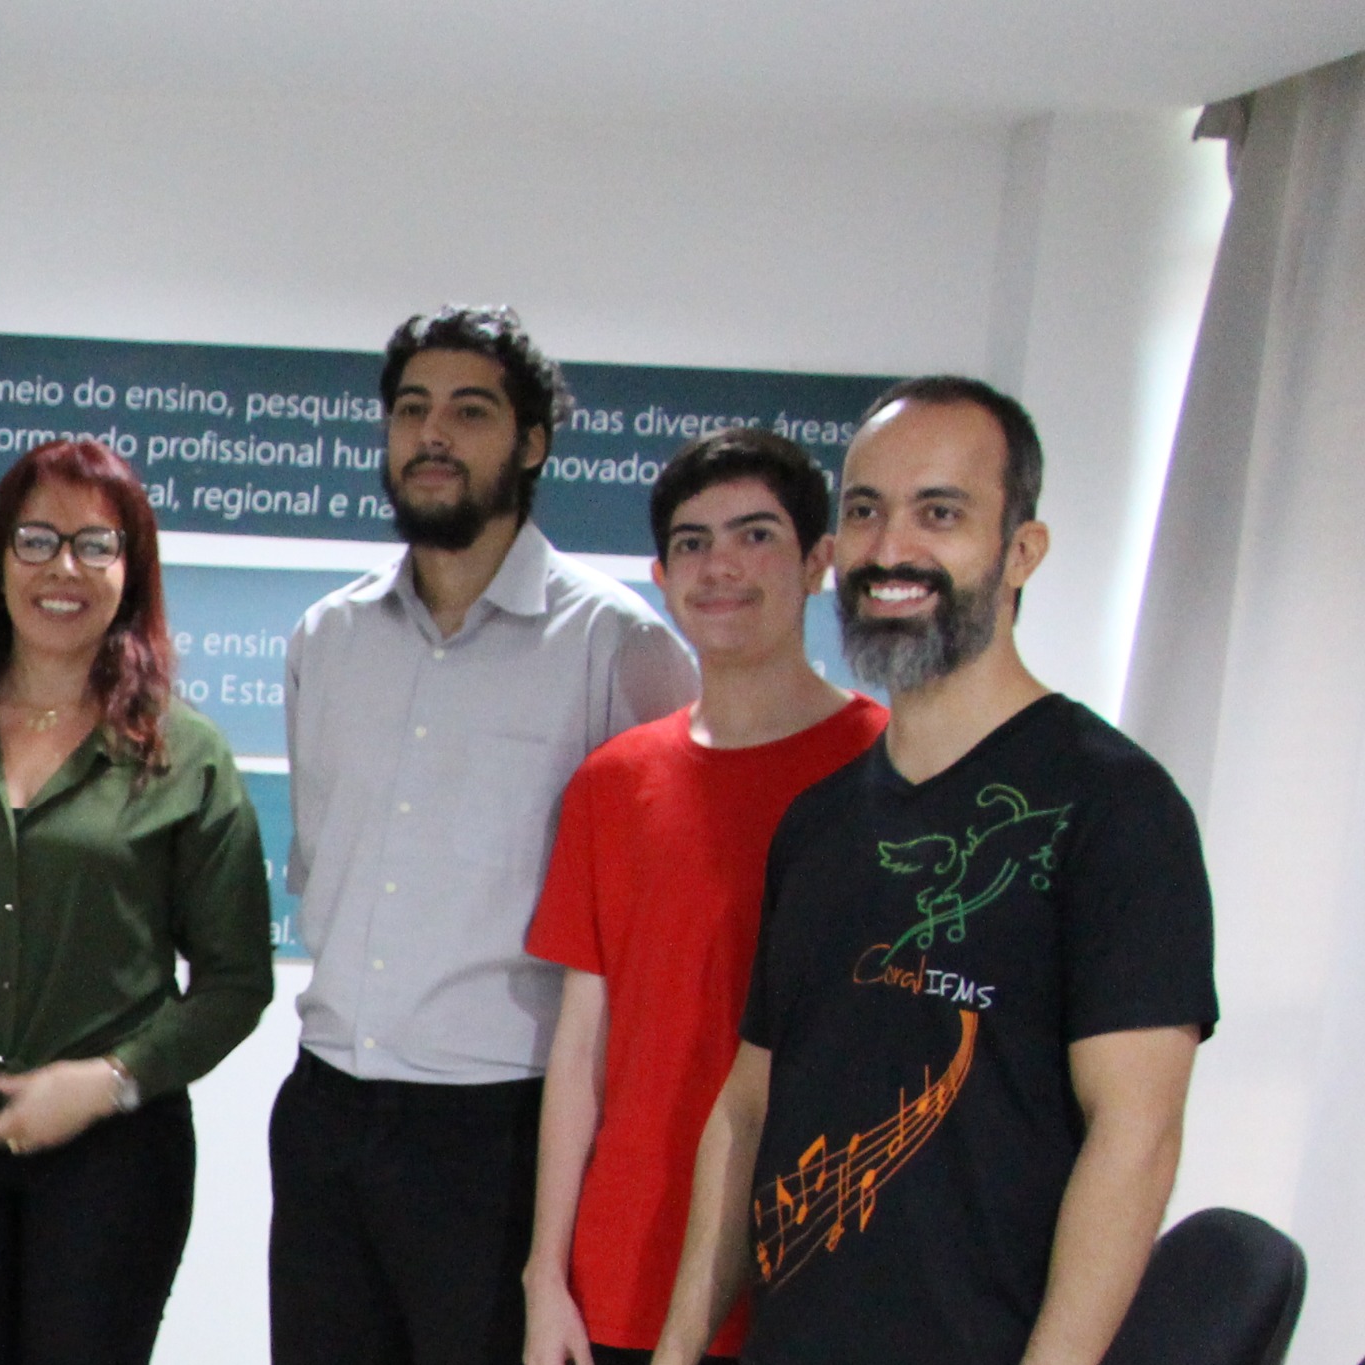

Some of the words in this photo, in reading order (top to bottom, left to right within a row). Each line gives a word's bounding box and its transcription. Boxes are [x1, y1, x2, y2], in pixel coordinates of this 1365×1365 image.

[72, 377, 116, 409] do
[124, 382, 235, 418] ensino,
[245, 391, 383, 426] pesquisa
[570, 406, 624, 434] nas
[146, 429, 324, 466] profissional
[540, 452, 668, 485] novado
[192, 482, 320, 520] regional
[329, 493, 349, 518] e
[203, 629, 287, 657] ensin
[221, 674, 286, 705] Esta
